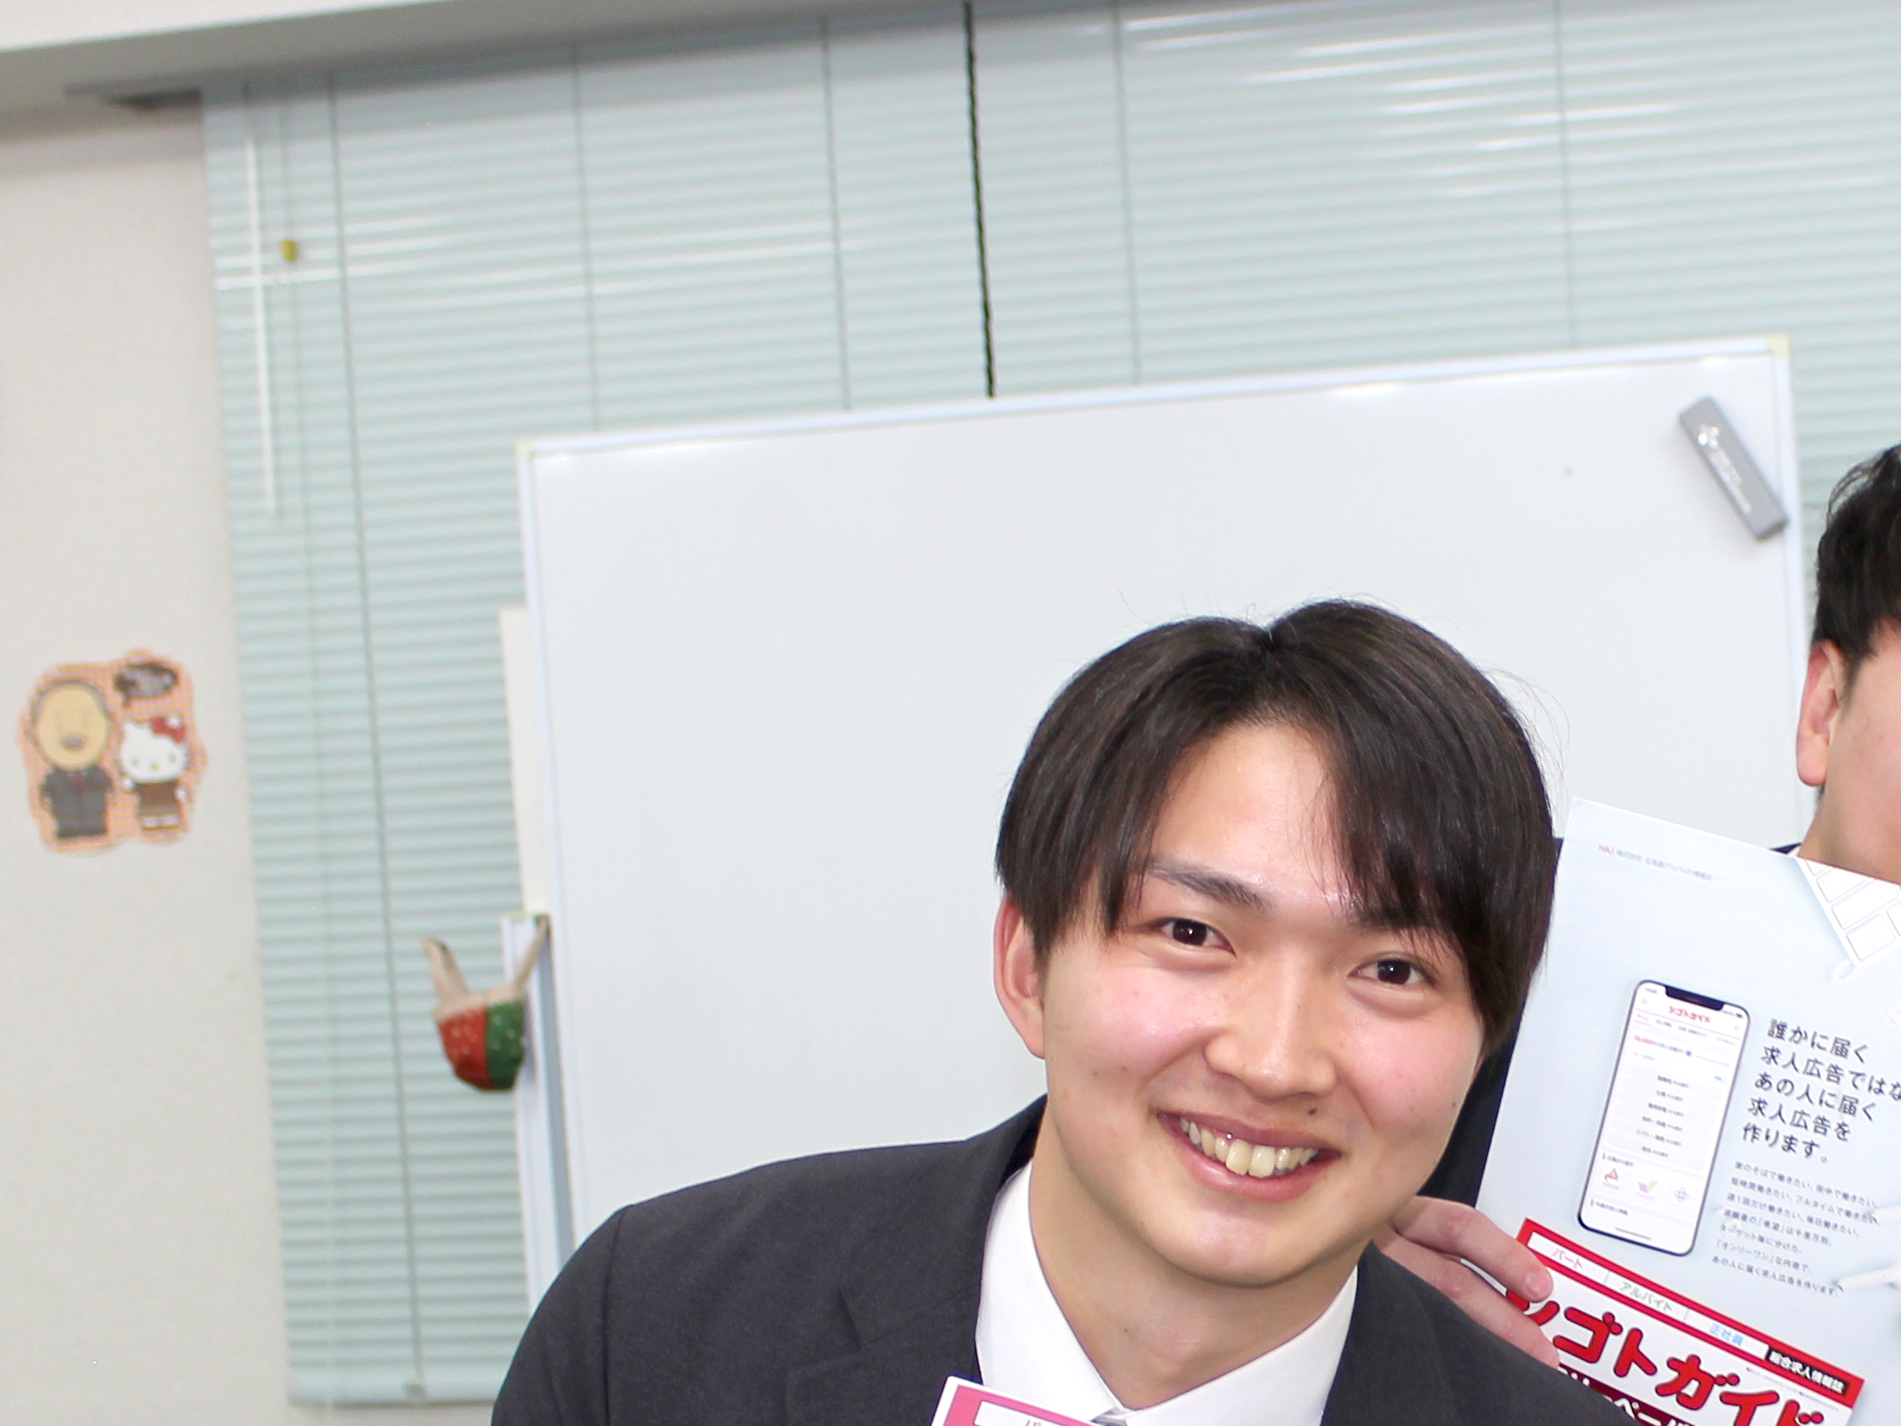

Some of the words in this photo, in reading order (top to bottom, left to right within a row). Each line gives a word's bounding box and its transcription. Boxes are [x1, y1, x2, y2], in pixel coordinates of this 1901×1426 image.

[1767, 1018, 1868, 1064] 誰かに届く
[1748, 1097, 1851, 1142] 求人広告を
[1754, 1071, 1876, 1122] あの人に届く
[1743, 1121, 1828, 1164] 作ります。
[1552, 1248, 1584, 1270] パート
[1619, 1281, 1674, 1312] アルバイト
[1709, 1323, 1744, 1347] 正社員
[1769, 1351, 1846, 1394] 総合求人情報誌
